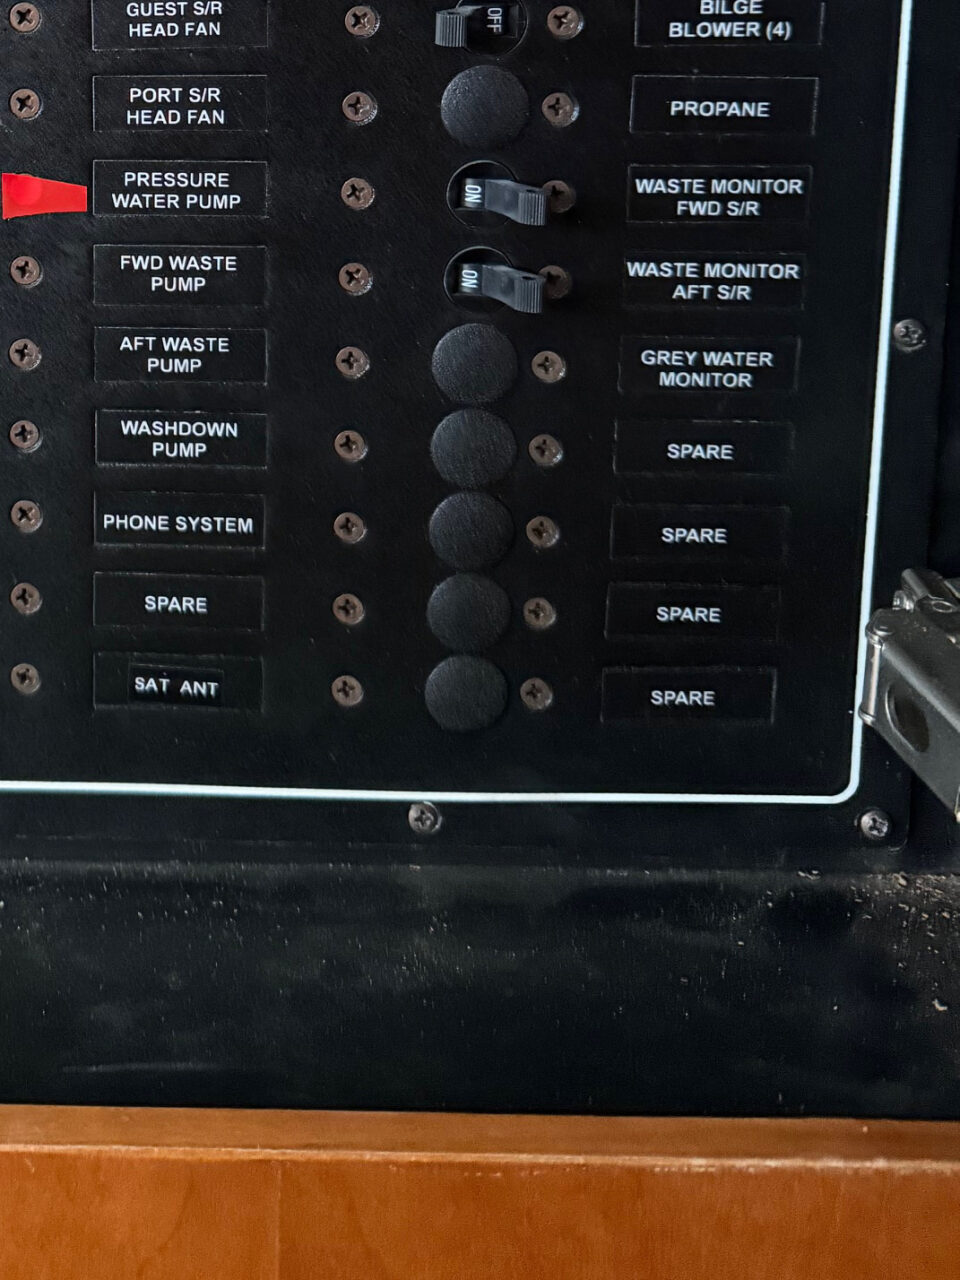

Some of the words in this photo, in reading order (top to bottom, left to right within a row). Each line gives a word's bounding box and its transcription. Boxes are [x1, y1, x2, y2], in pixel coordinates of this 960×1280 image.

[126, 2, 187, 17] GUEST
[192, 1, 223, 16] S/R
[700, 0, 763, 15] BILGE
[488, 6, 502, 34] OFF
[128, 23, 179, 37] HEAD
[184, 22, 221, 36] FAN
[668, 21, 761, 38] BLOWER
[766, 21, 791, 40] (4)
[129, 88, 183, 103] PORT
[189, 88, 221, 103] S/R
[126, 110, 181, 125] HEAD
[187, 110, 225, 125] FAN
[670, 101, 771, 118] PROPANE
[124, 172, 230, 188] PRESSURE
[635, 179, 705, 194] WASTE
[711, 179, 804, 194] MONITOR
[112, 193, 180, 208] WATER
[186, 193, 241, 209] PUMP
[465, 184, 482, 203] ON
[677, 200, 722, 216] FWD
[727, 200, 760, 216] S/R
[120, 255, 163, 271] FWD
[168, 255, 237, 271] WASTE
[627, 262, 699, 278] WASTE
[705, 263, 800, 279] MONITOR
[151, 277, 206, 292] PUMP
[462, 269, 478, 288] ON
[672, 284, 711, 300] AFT
[717, 284, 752, 301] S/R
[119, 337, 155, 351] AFT
[161, 337, 230, 353] WASTE
[147, 358, 202, 373] PUMP
[641, 350, 697, 366] GREY
[702, 351, 774, 367] WATER
[659, 372, 752, 388] MONITOR
[121, 421, 239, 438] WASHDOWN
[152, 442, 207, 458] PUMP
[667, 444, 735, 460] SPARE
[103, 515, 170, 531] PHONE
[175, 516, 254, 533] SYSTEM
[661, 527, 728, 543] SPARE
[144, 596, 208, 613] SPARE
[656, 607, 721, 623] SPARE
[135, 677, 170, 693] SAT
[180, 680, 219, 696] ANT
[650, 690, 716, 706] SPARE
